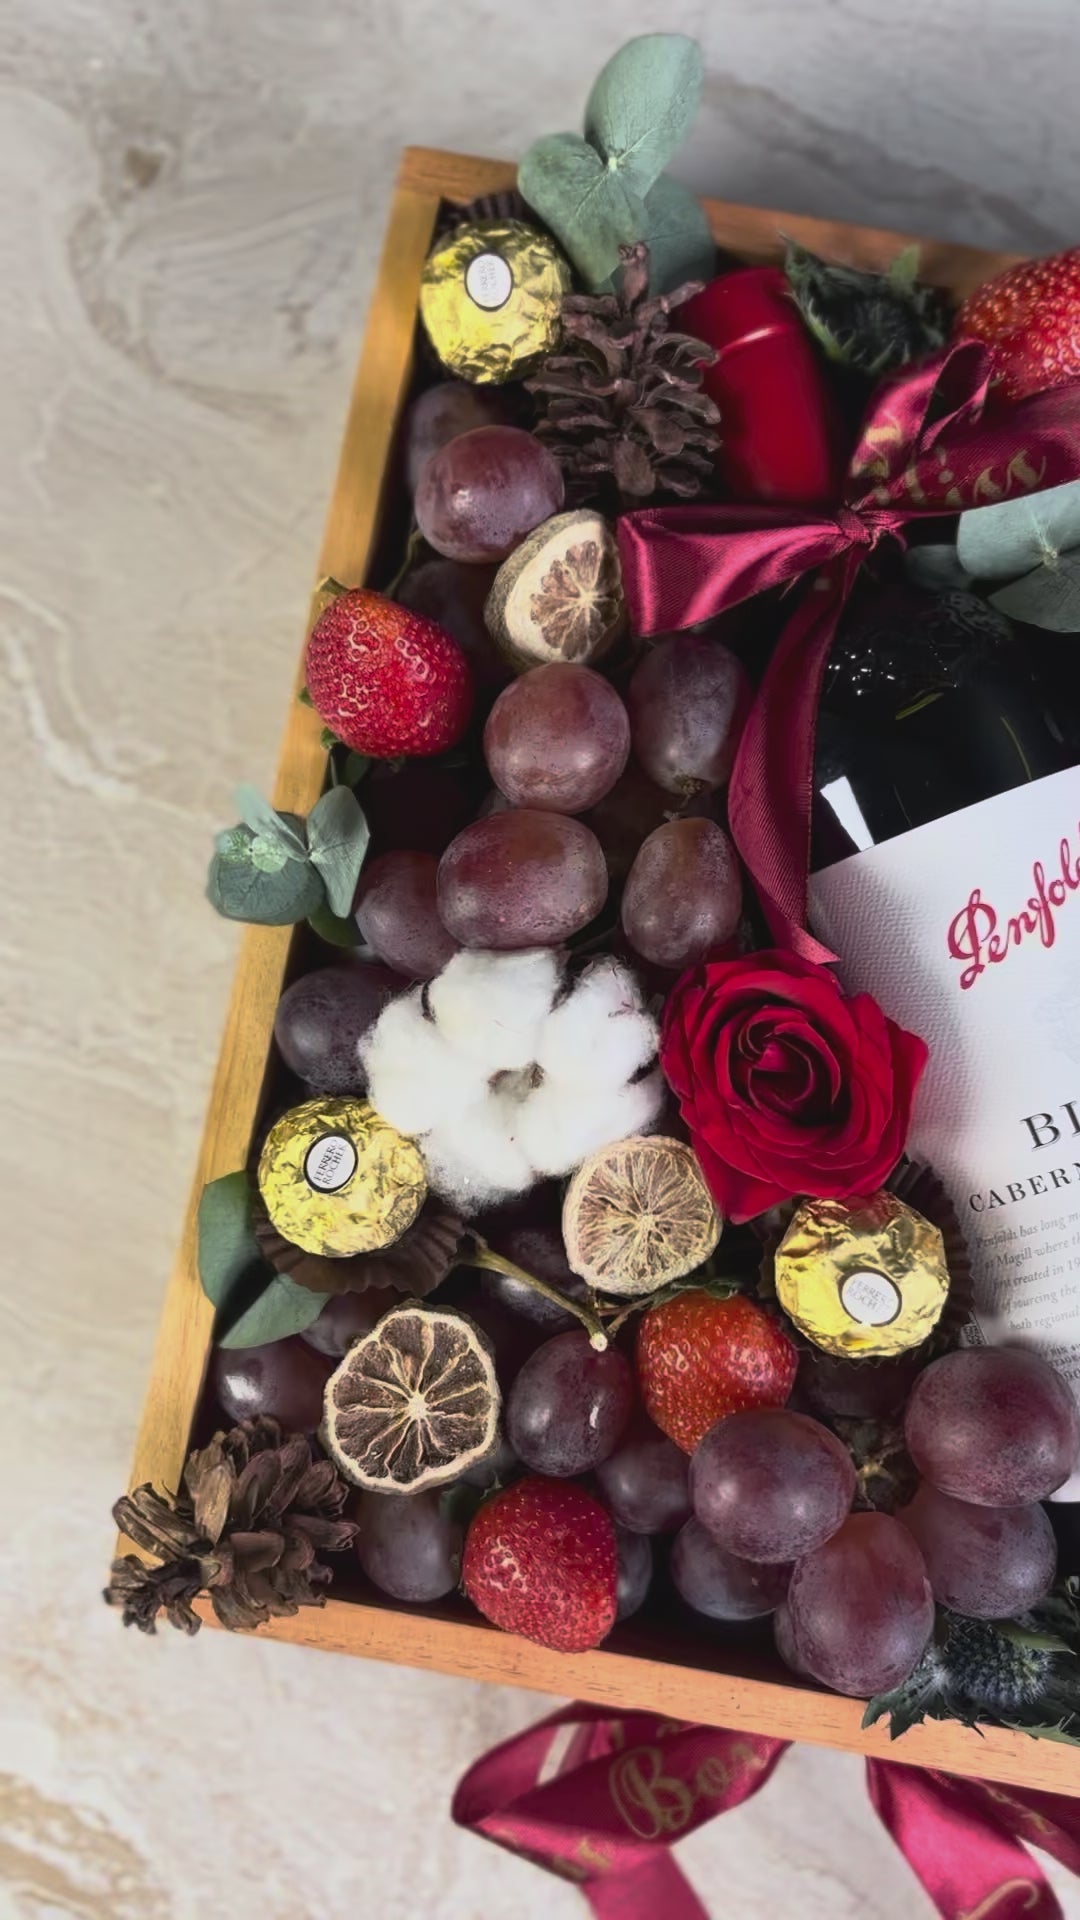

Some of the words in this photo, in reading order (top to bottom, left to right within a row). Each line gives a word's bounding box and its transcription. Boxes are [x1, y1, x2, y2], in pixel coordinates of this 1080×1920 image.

[948, 821, 1080, 990] Penfol
[313, 1139, 338, 1181] FERRERO
[322, 1144, 348, 1185] ROCHER
[1019, 1225, 1039, 1238] has
[1040, 1217, 1066, 1231] long
[996, 1246, 1033, 1267] Magill
[1033, 1239, 1070, 1257] where
[1013, 1265, 1050, 1288] created
[1052, 1264, 1064, 1276] in
[1060, 1284, 1077, 1297] the
[1010, 1317, 1032, 1329] both
